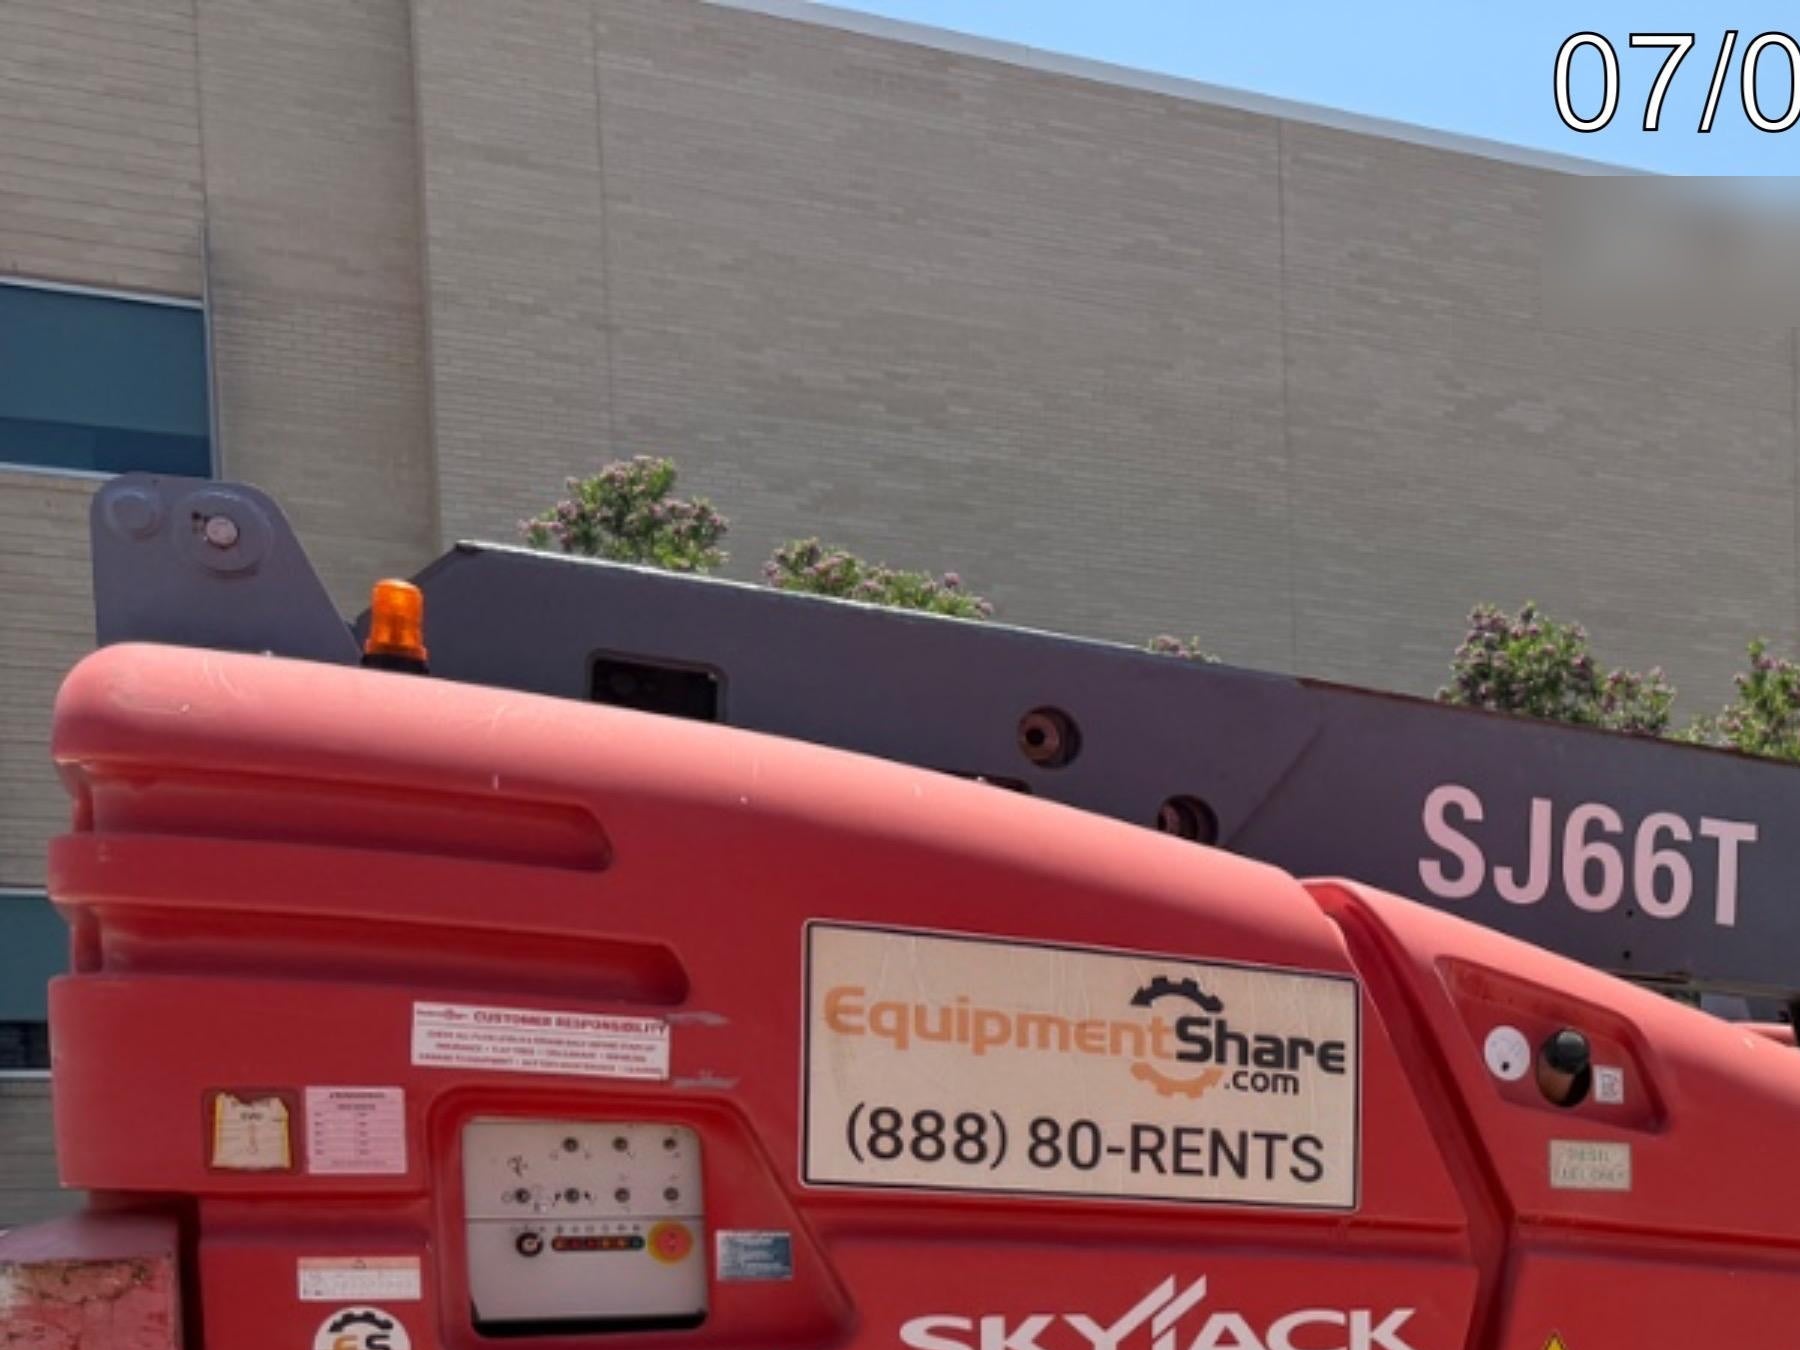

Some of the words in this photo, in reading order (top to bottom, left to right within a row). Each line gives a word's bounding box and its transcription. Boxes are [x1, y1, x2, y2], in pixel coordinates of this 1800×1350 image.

[1419, 786, 1758, 927] SJ66T
[473, 1011, 552, 1028] CUSTOMER
[555, 1015, 667, 1035] RESPONSIBILITY
[824, 986, 1346, 1075] EquipmentShare
[1224, 1068, 1299, 1096] .com
[847, 1102, 1007, 1170] (888)
[1028, 1117, 1324, 1182] 80-RENTS
